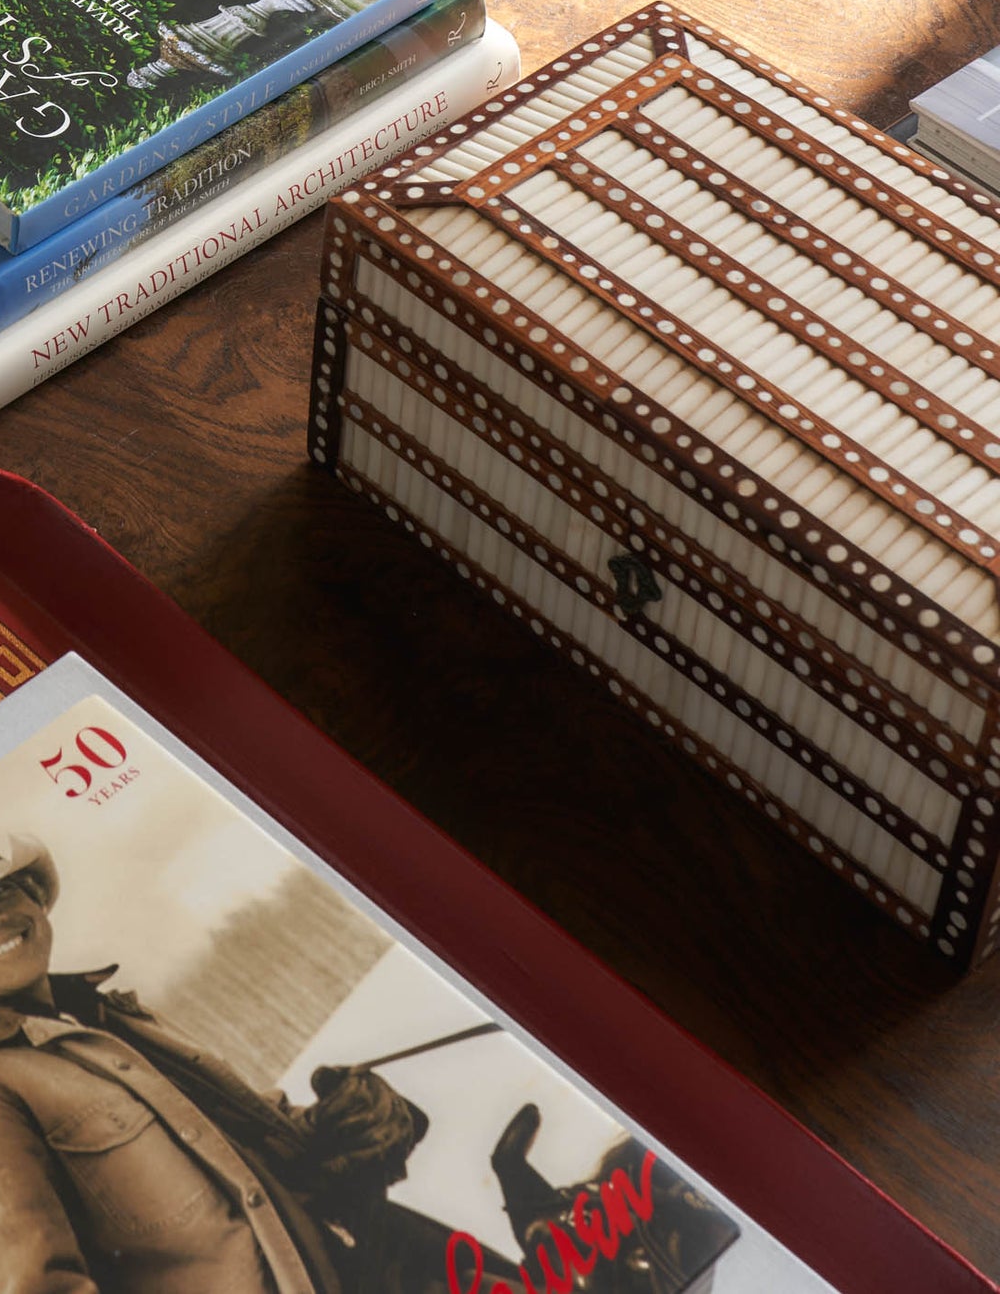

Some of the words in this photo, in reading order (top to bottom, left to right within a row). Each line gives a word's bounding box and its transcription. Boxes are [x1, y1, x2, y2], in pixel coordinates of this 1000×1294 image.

[25, 213, 137, 294] RENEWING
[142, 141, 252, 221] TRADITION
[359, 78, 381, 96] ERIC
[387, 53, 417, 77] SMITH
[63, 136, 181, 219] GARDENS
[205, 80, 276, 134] STYLE
[199, 178, 231, 202] SMITH
[31, 314, 91, 369] NEW
[97, 207, 268, 324] TRADITIONAL
[275, 90, 449, 217] ARCHITECTURE
[39, 726, 127, 798] 50
[87, 766, 141, 806] YEARS
